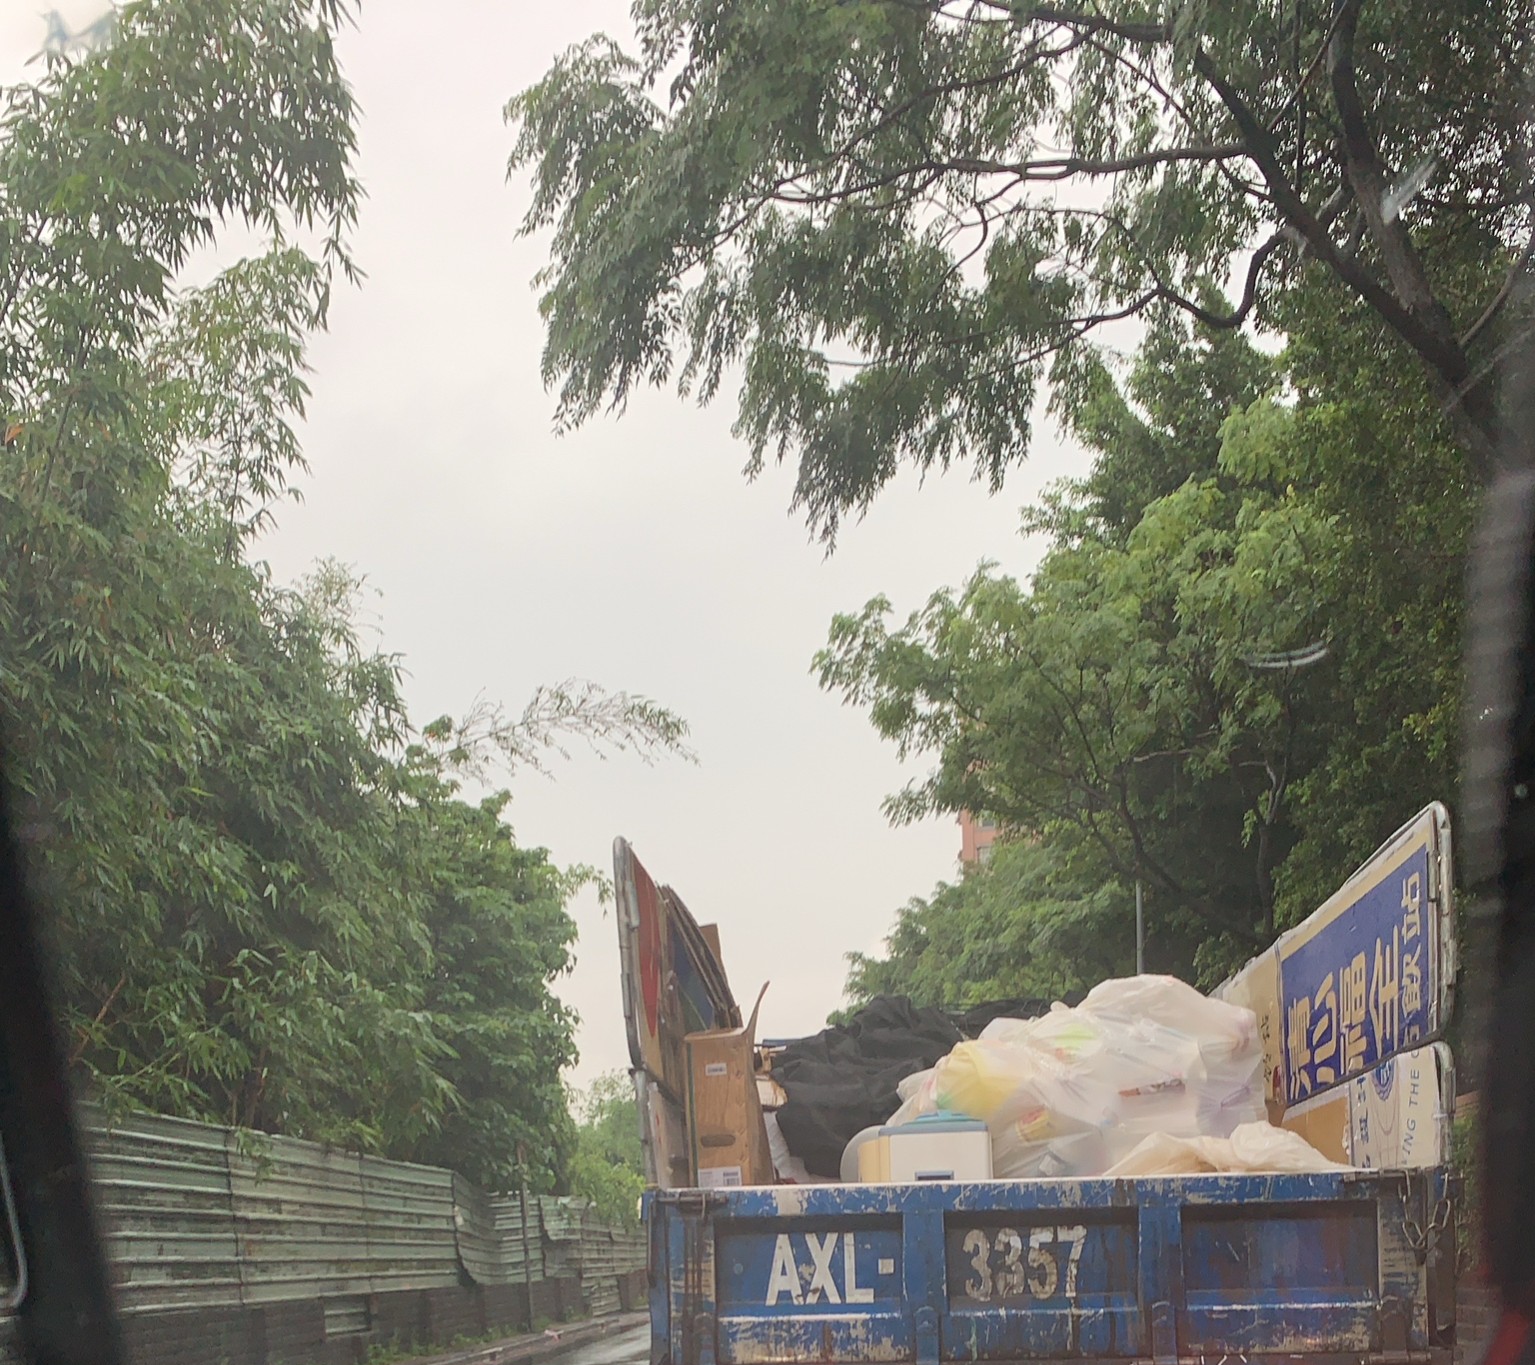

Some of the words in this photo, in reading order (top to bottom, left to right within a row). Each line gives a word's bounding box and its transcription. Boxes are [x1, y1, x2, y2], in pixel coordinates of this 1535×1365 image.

[1287, 924, 1399, 1101] 清心福全
[1408, 1068, 1420, 1107] THE
[765, 1232, 894, 1306] AXL-
[962, 1225, 1087, 1302] 3357
